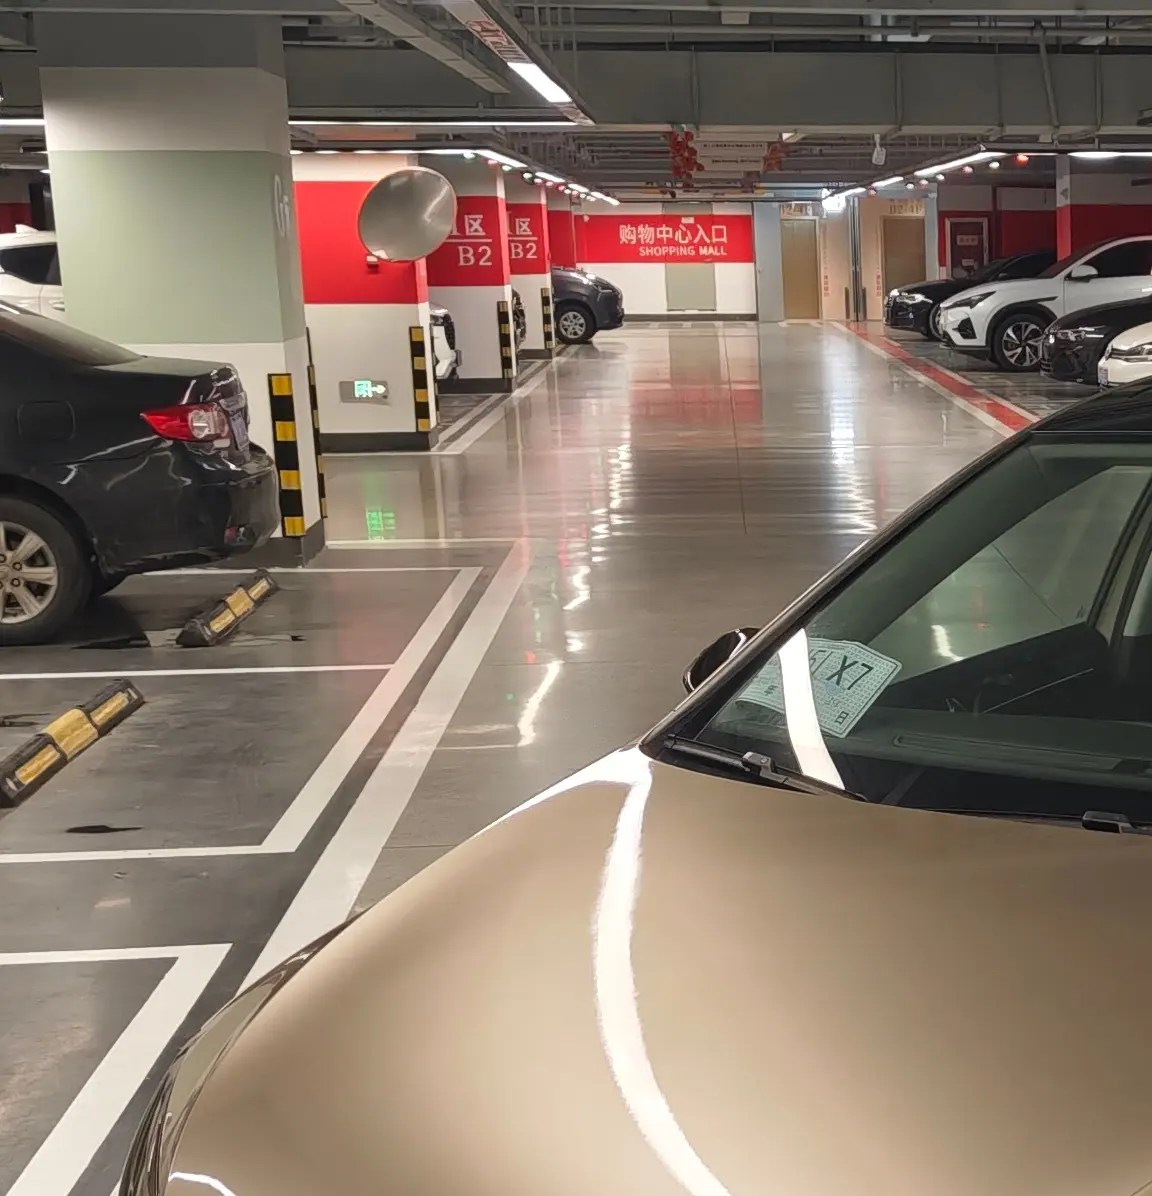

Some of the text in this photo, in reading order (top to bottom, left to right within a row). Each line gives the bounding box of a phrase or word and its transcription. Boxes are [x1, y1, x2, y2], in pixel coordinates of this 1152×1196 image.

[619, 223, 728, 246] 购物中心入口
[457, 245, 493, 267] B2
[509, 242, 538, 260] B2
[639, 245, 728, 257] SHOPPING MALL
